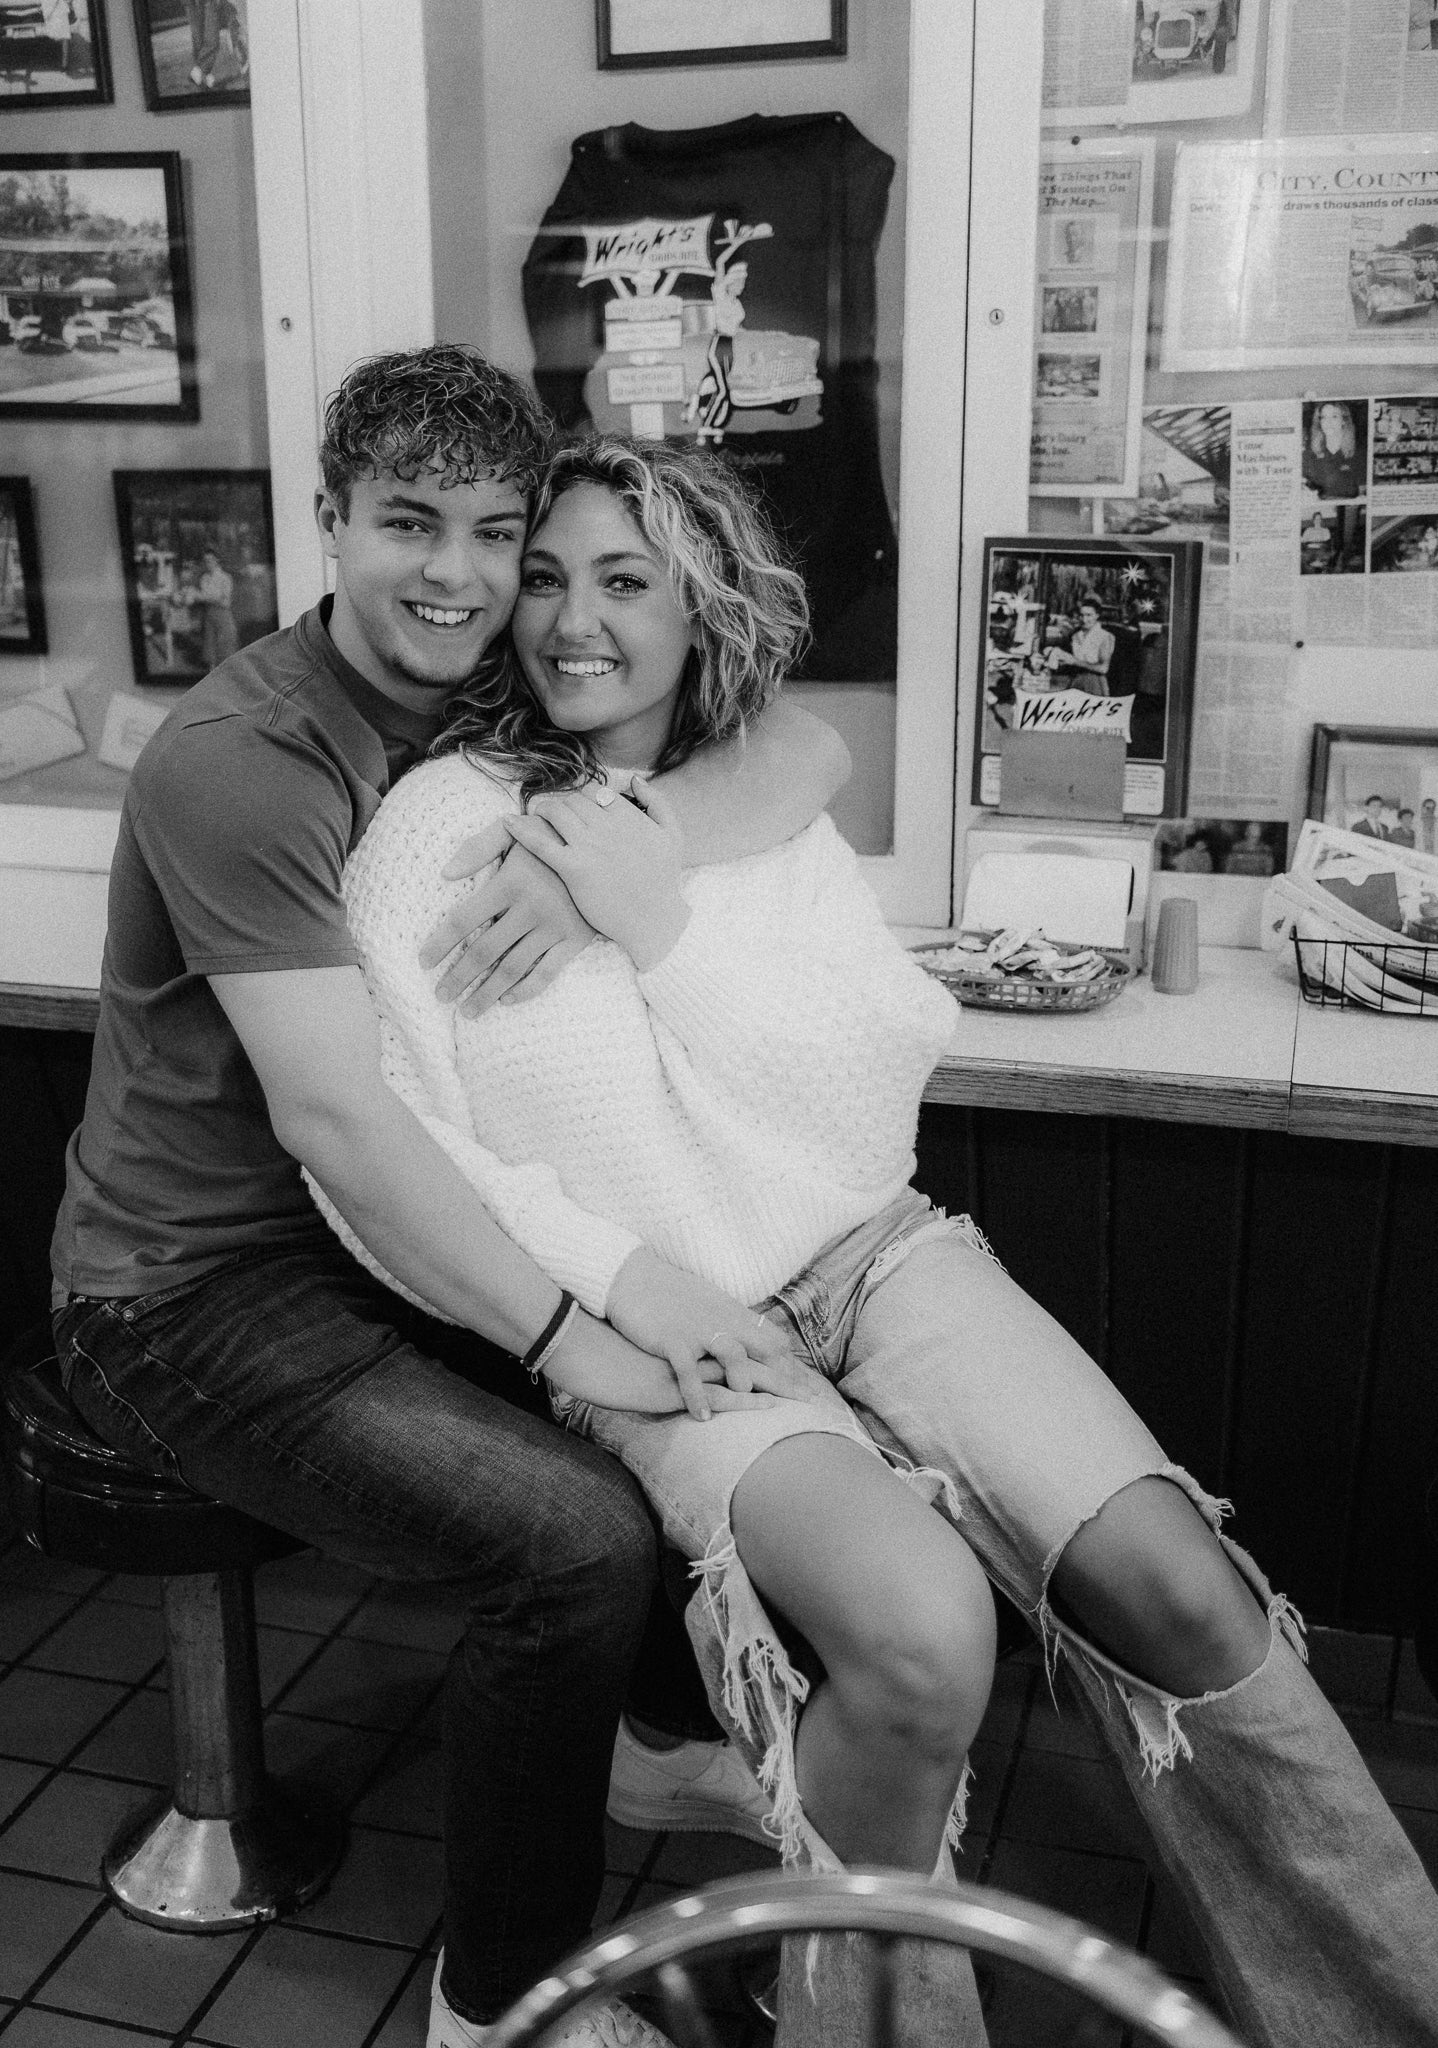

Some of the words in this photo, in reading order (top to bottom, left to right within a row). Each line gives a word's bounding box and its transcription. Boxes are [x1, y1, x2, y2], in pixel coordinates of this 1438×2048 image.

[1104, 170, 1132, 180] That
[1283, 201, 1320, 211] draws
[1323, 198, 1388, 210] thousands
[1391, 197, 1405, 207] of
[593, 226, 696, 267] Wright's
[1235, 464, 1259, 475] with
[1265, 464, 1293, 475] Taste
[1019, 697, 1123, 731] Wright's
